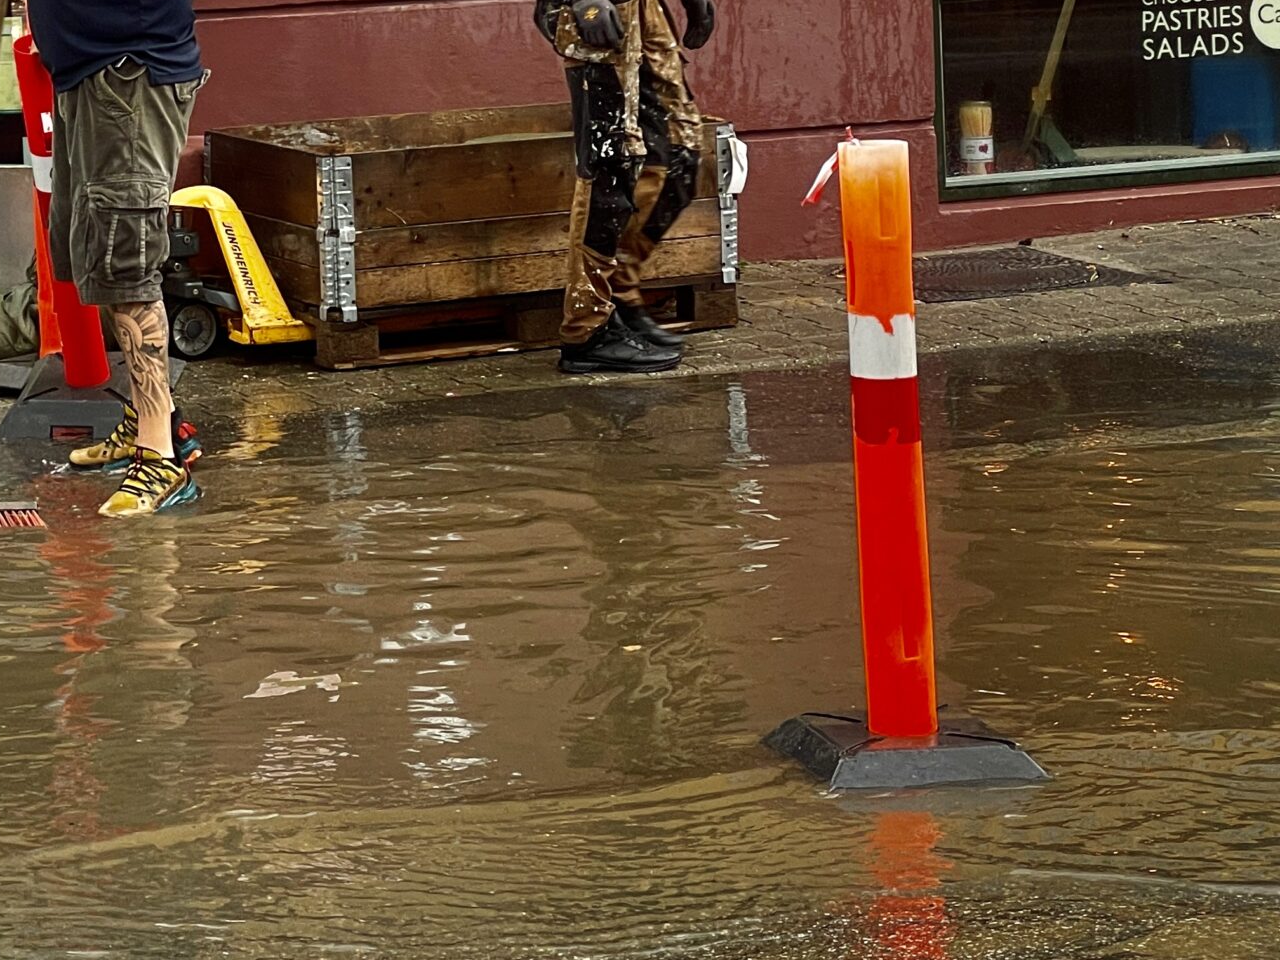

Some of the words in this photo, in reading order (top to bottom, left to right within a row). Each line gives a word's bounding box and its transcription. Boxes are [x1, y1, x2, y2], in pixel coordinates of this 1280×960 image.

[1141, 5, 1243, 32] PASTRIES
[1143, 32, 1244, 60] SALADS
[222, 221, 260, 305] JUNGHEINRICH
